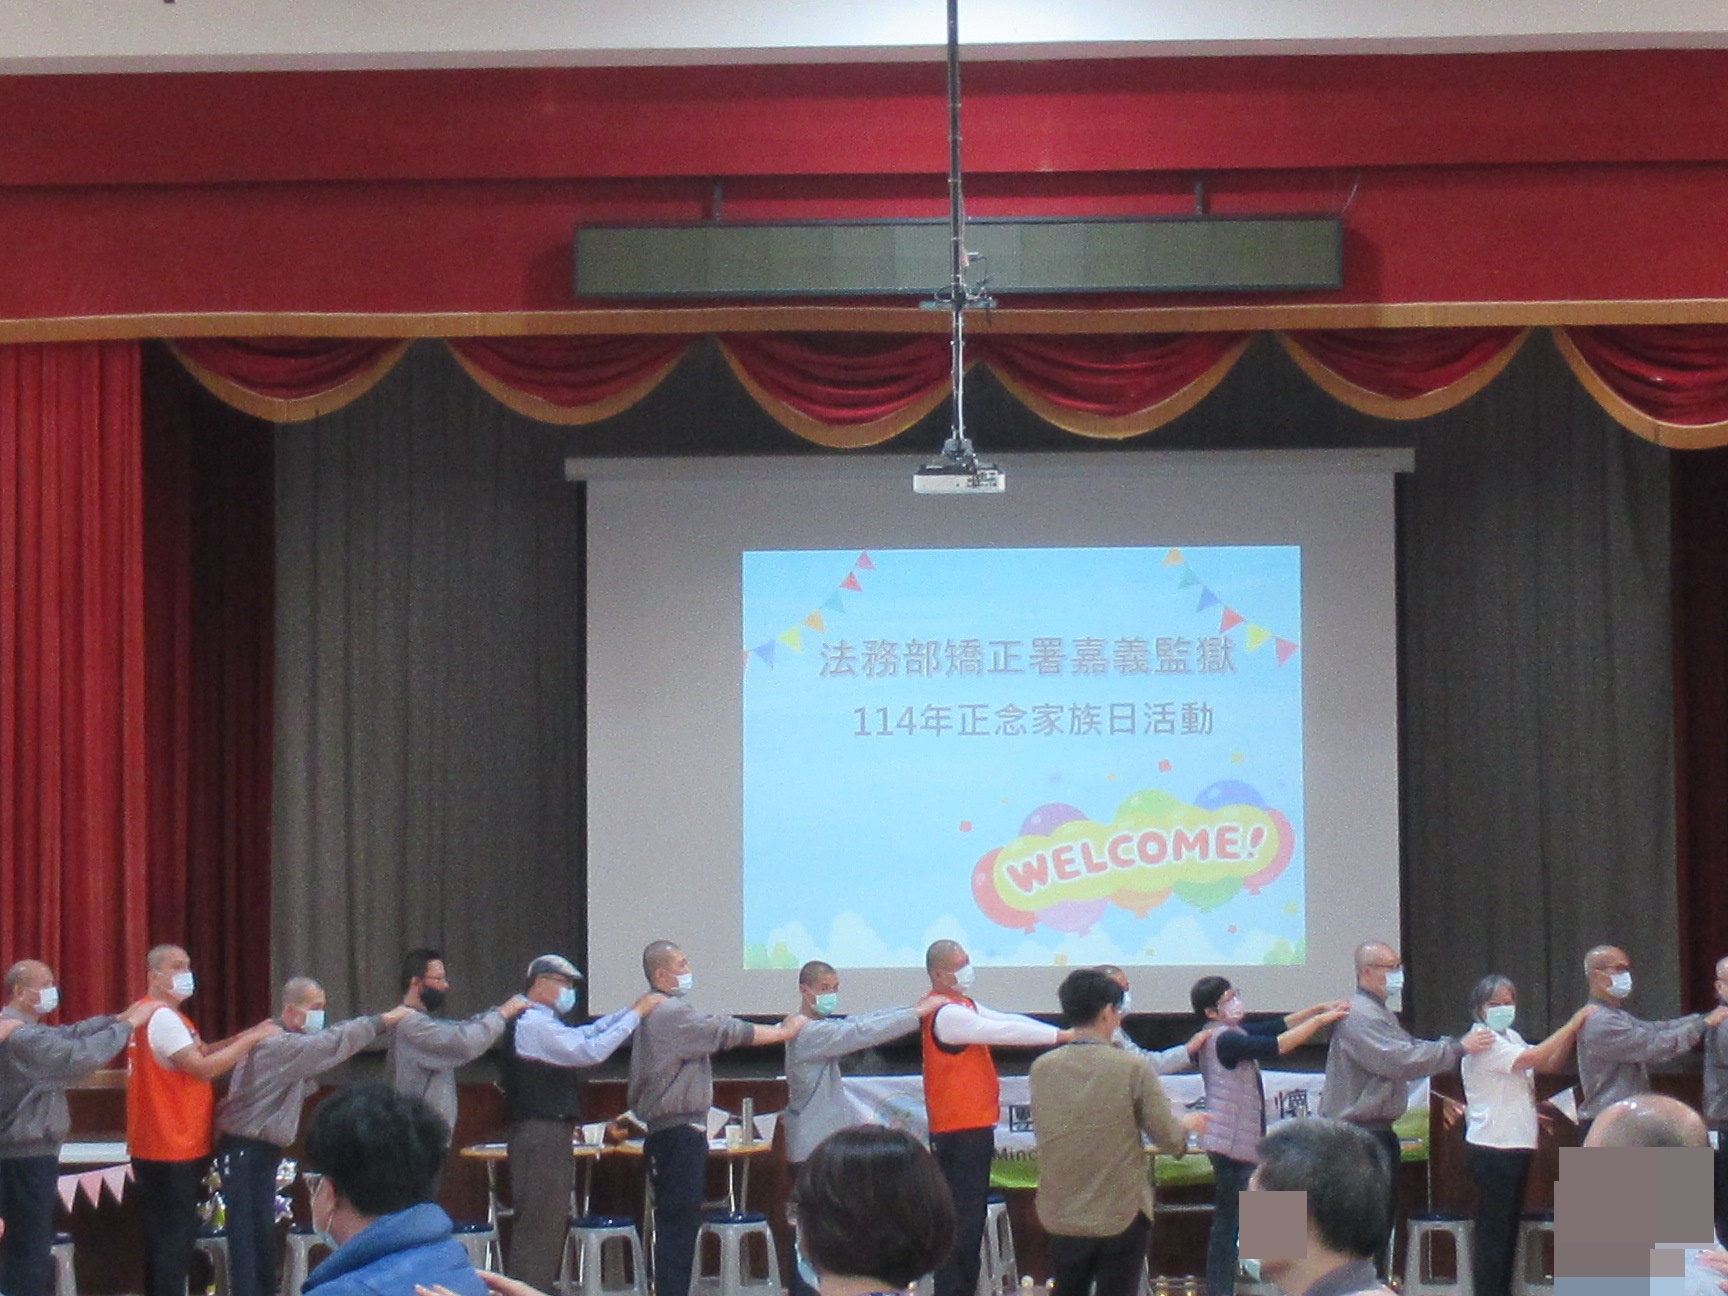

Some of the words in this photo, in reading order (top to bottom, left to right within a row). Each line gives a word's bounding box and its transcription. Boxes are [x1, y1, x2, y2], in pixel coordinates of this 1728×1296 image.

[818, 636, 1236, 679] 法務部矯正署嘉義監獄
[853, 702, 1214, 737] 114年正念家族日活動
[1005, 824, 1269, 894] WELCOME!
